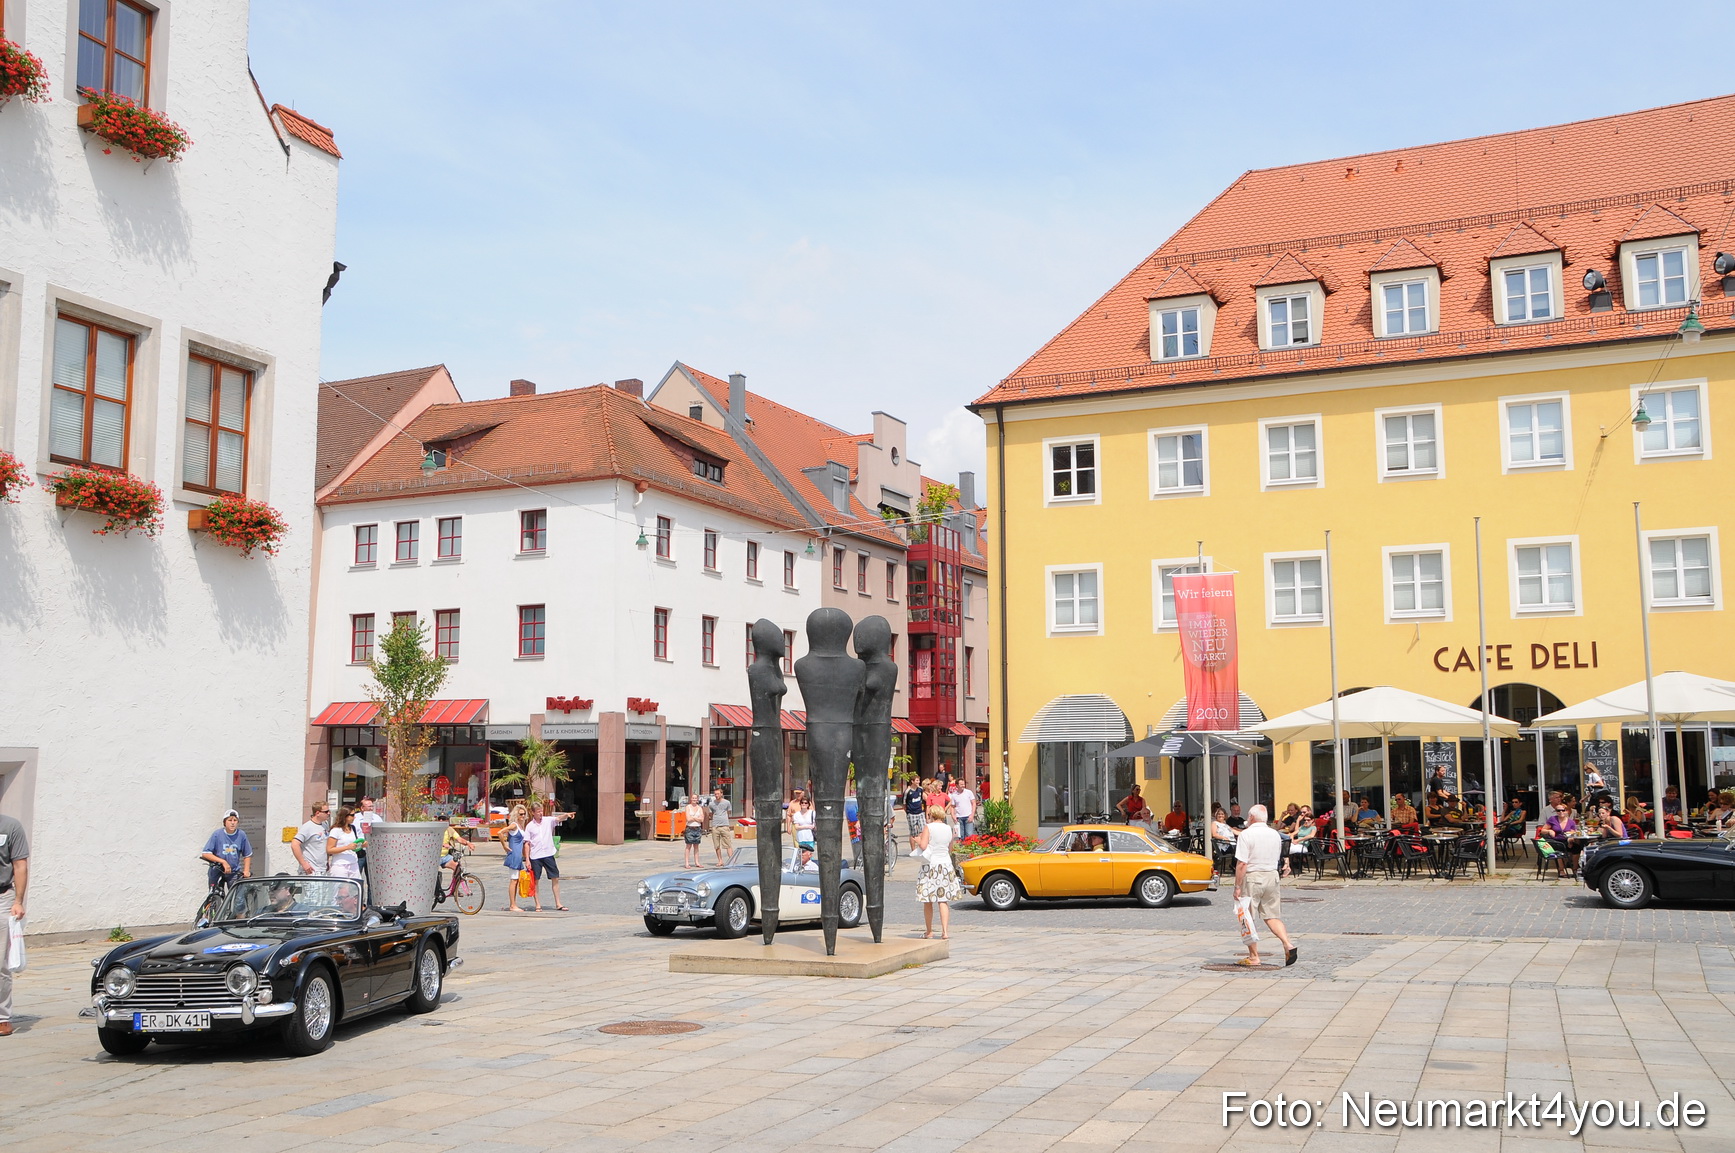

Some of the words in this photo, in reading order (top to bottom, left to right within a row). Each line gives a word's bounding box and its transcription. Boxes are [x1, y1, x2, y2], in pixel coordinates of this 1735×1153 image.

[1177, 589, 1199, 599] Wir
[1201, 588, 1233, 599] feiern
[1189, 619, 1226, 629] IMMER
[1188, 628, 1229, 639] WIEDER
[1192, 638, 1226, 652] NEU
[1194, 652, 1227, 662] MARKT
[1433, 644, 1513, 672] CAFE
[1531, 641, 1598, 669] DELI
[546, 696, 594, 714] Döpfer
[1196, 707, 1228, 720] 2010
[142, 1015, 157, 1027] ER
[166, 1015, 181, 1027] DK
[185, 1014, 209, 1026] 41H
